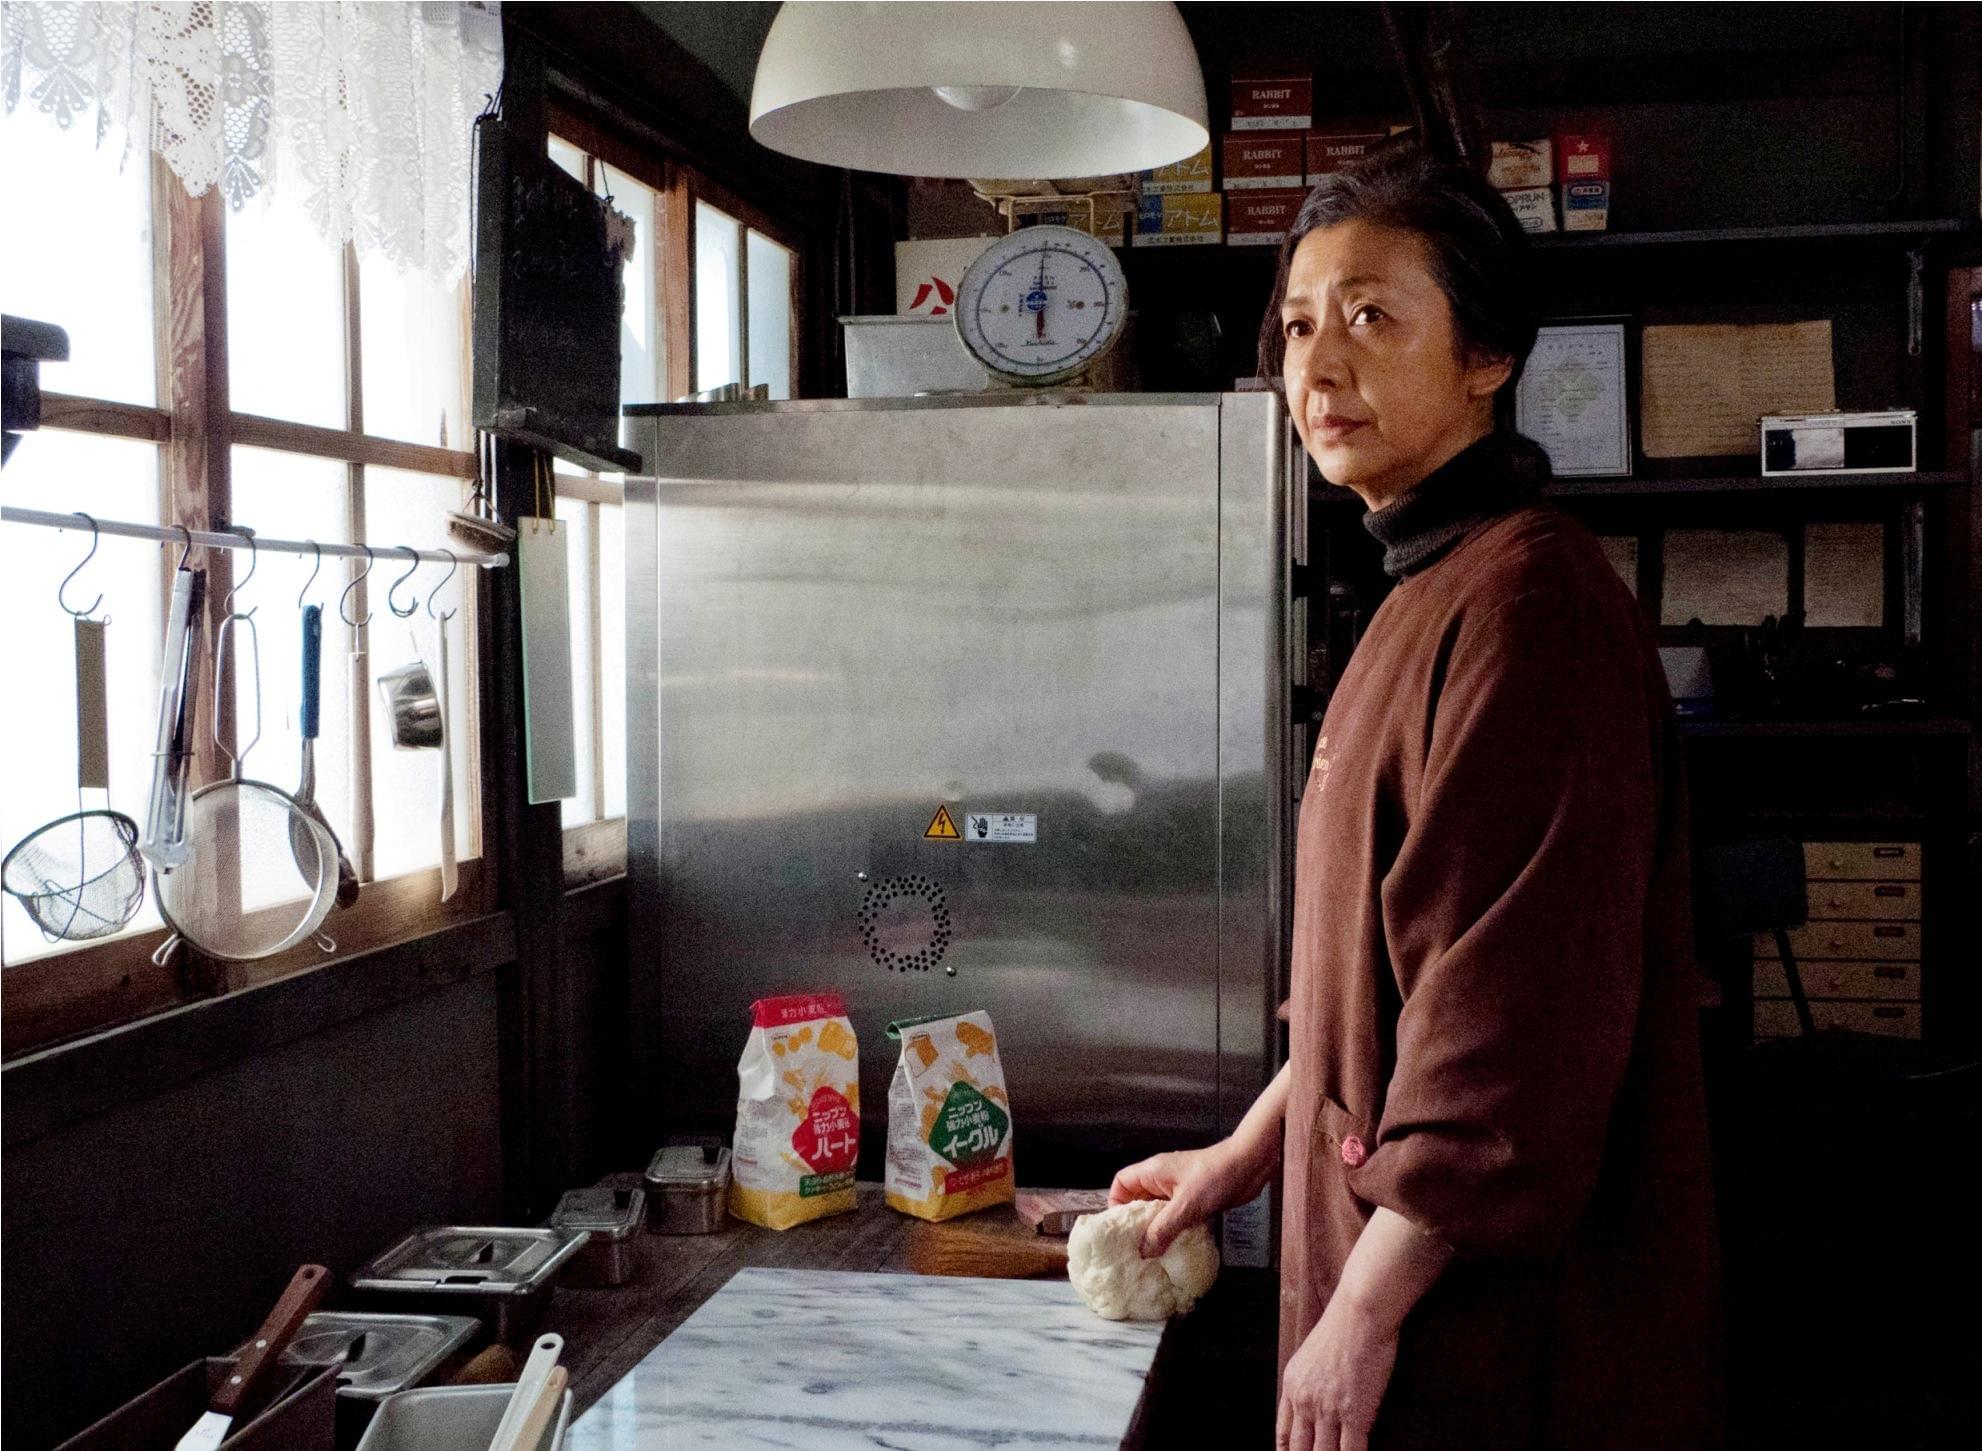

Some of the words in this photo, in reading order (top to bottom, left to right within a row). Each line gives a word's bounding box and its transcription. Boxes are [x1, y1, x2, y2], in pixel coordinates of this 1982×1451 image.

[1251, 88, 1292, 100] RABBIT
[1243, 149, 1283, 161] RABBIT
[1326, 145, 1366, 156] RABBIT
[1165, 209, 1218, 228] アトム
[1247, 205, 1287, 216] RABBIT
[811, 1106, 847, 1122] ニップン
[947, 1100, 983, 1119] ニップン
[946, 1110, 990, 1132] 強力小麦粉
[811, 1132, 857, 1161] ハート
[942, 1125, 999, 1158] イーグル
